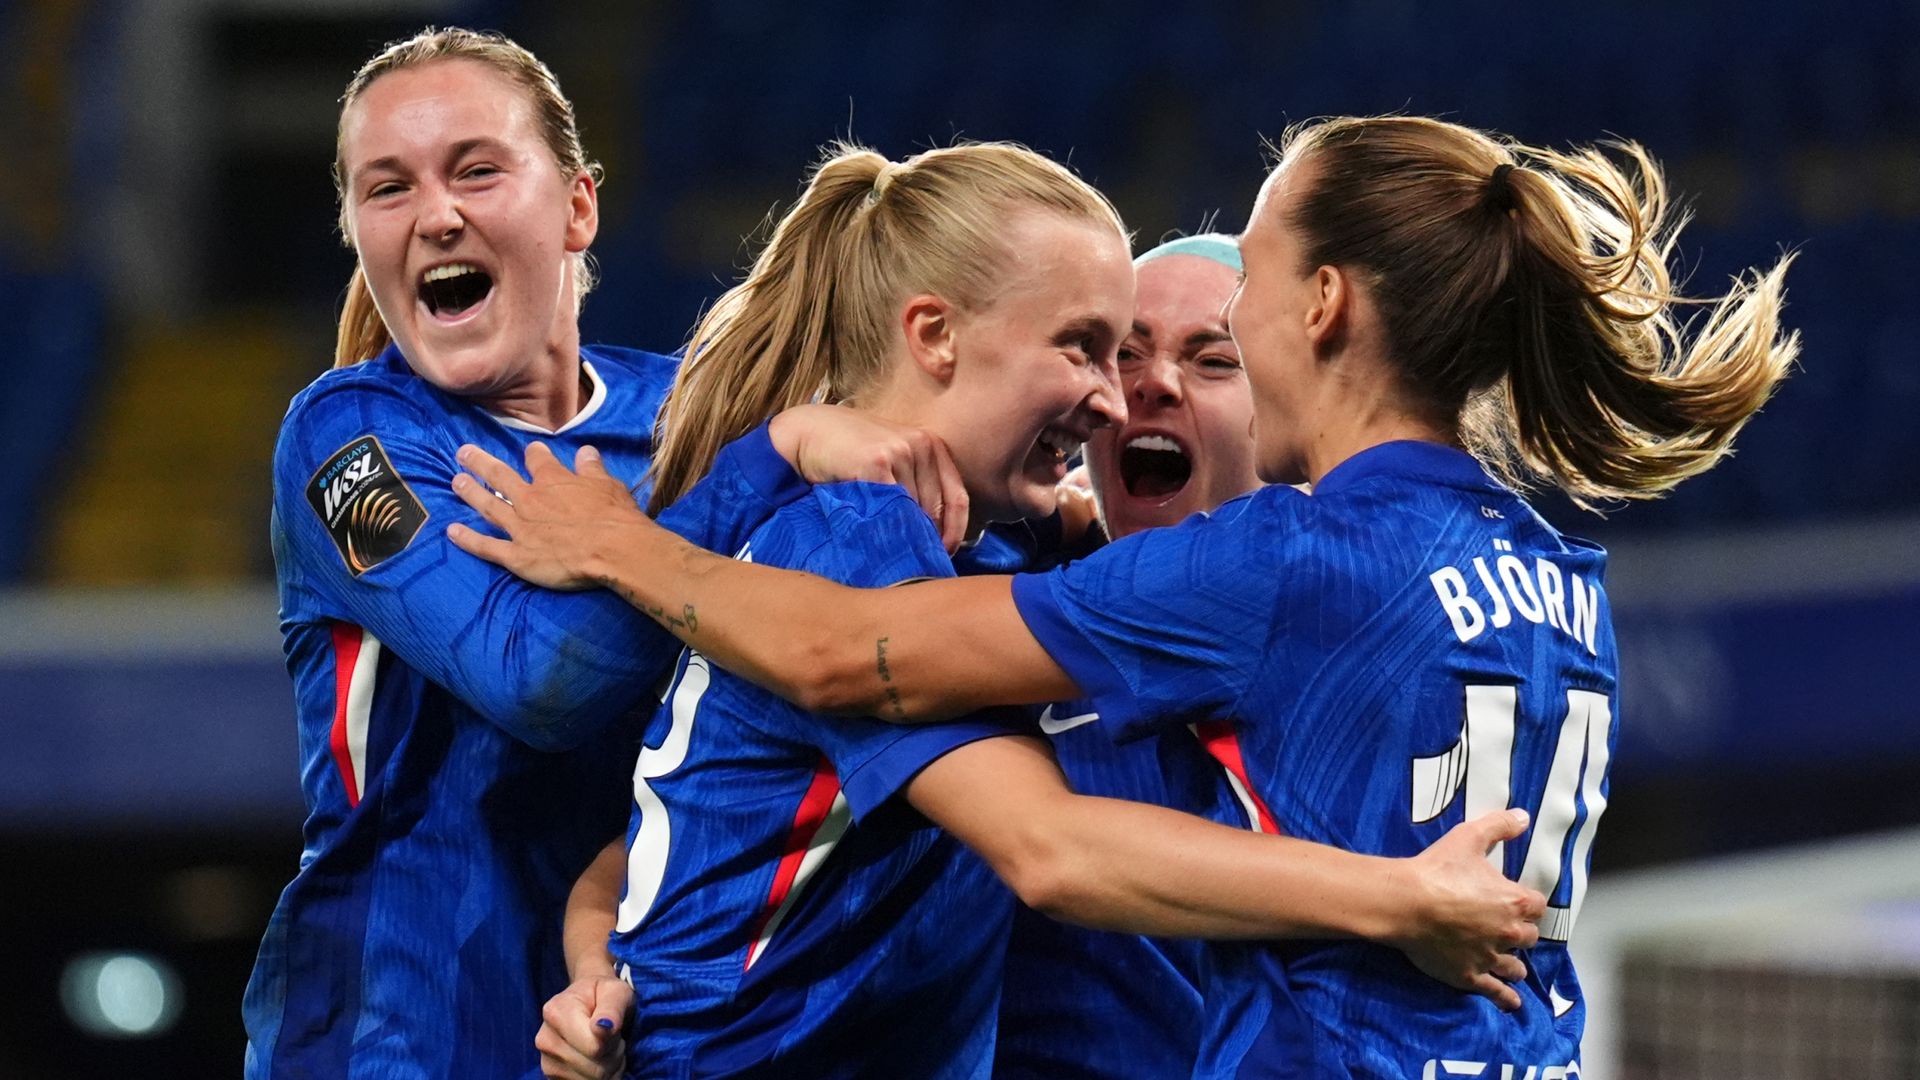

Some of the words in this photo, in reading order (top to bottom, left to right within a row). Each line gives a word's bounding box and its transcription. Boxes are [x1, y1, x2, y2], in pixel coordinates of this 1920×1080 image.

[324, 453, 382, 521] WSL
[327, 444, 369, 479] BARCLAYS
[1429, 538, 1598, 656] BJÖRN
[1412, 684, 1612, 1017] 14
